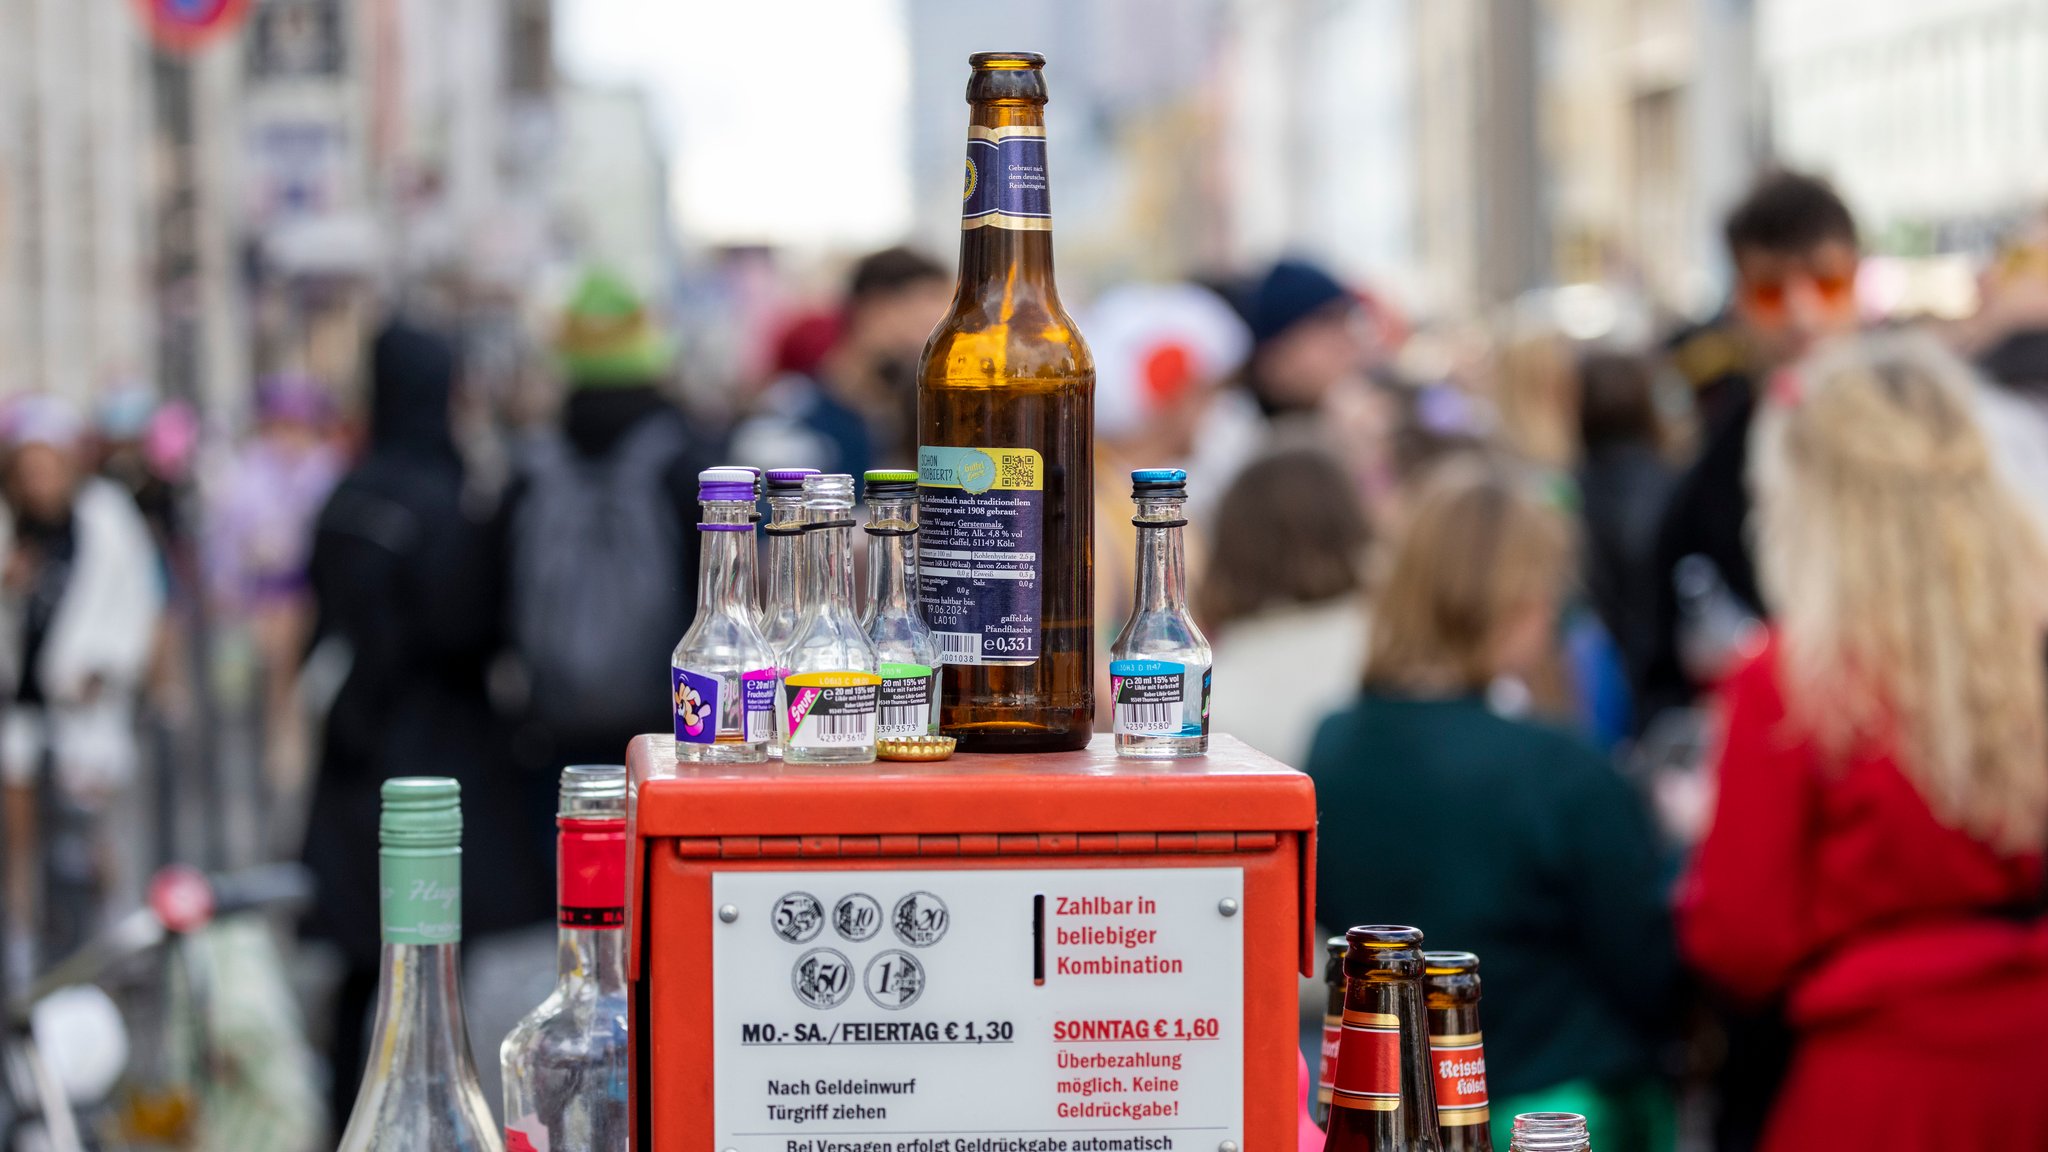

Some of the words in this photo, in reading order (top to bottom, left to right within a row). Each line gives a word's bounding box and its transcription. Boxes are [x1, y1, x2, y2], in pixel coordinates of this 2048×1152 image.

[959, 497, 976, 505] nach
[977, 498, 1031, 507] traditionellem
[953, 506, 966, 514] seit
[967, 506, 985, 515] 1908
[986, 508, 1019, 517] gebraut.
[957, 519, 1004, 529] Gerstenmalz,
[953, 528, 969, 537] Bier,
[971, 529, 986, 537] Alk.
[988, 530, 1000, 538] 4,8
[1001, 530, 1010, 538] %
[1011, 530, 1023, 538] vol
[949, 537, 971, 546] Gaffel,
[972, 538, 995, 547] 51149
[997, 539, 1015, 547] Köln
[973, 552, 1017, 560] Kohlenhydrate
[941, 596, 962, 605] haltbar
[963, 598, 976, 606] bis:
[927, 604, 968, 615] 19.06.2024
[1000, 614, 1033, 624] gaffel.de
[985, 624, 1033, 634] Pfandflasche
[996, 637, 1025, 652] 0,33
[883, 679, 892, 687] 20
[893, 679, 902, 687] ml
[903, 679, 917, 687] 15%
[918, 677, 927, 685] vol
[1153, 676, 1168, 684] 15%
[1169, 674, 1180, 683] vol
[896, 724, 917, 732] 3573
[1147, 721, 1170, 730] 3580
[846, 732, 865, 741] 3610
[1056, 897, 1134, 915] Zahlbar
[1138, 896, 1156, 914] in
[855, 907, 874, 927] 10
[915, 908, 945, 932] 20
[1057, 926, 1157, 949] beliebiger
[1057, 955, 1183, 975] Kombination
[814, 964, 848, 994] 50
[945, 1021, 958, 1041] €
[965, 1021, 1014, 1043] 1,30
[1053, 1020, 1149, 1040] SONNTAG
[1154, 1019, 1168, 1038] €
[1174, 1018, 1219, 1041] 1,60
[1057, 1050, 1182, 1070] Überbezahlung
[768, 1080, 810, 1095] Nach
[815, 1078, 916, 1095] Geldeinwurf
[1057, 1078, 1128, 1096] möglich.
[1133, 1077, 1179, 1092] Keine
[768, 1104, 829, 1123] Türgriff
[832, 1104, 886, 1119] ziehen
[1057, 1101, 1179, 1120] Geldrückgabe!
[787, 1140, 812, 1152] Bei
[817, 1139, 891, 1152] Versagen
[897, 1138, 951, 1152] erfolgt
[955, 1136, 1067, 1152] Geldrückgabe
[1072, 1135, 1172, 1152] automatisch
